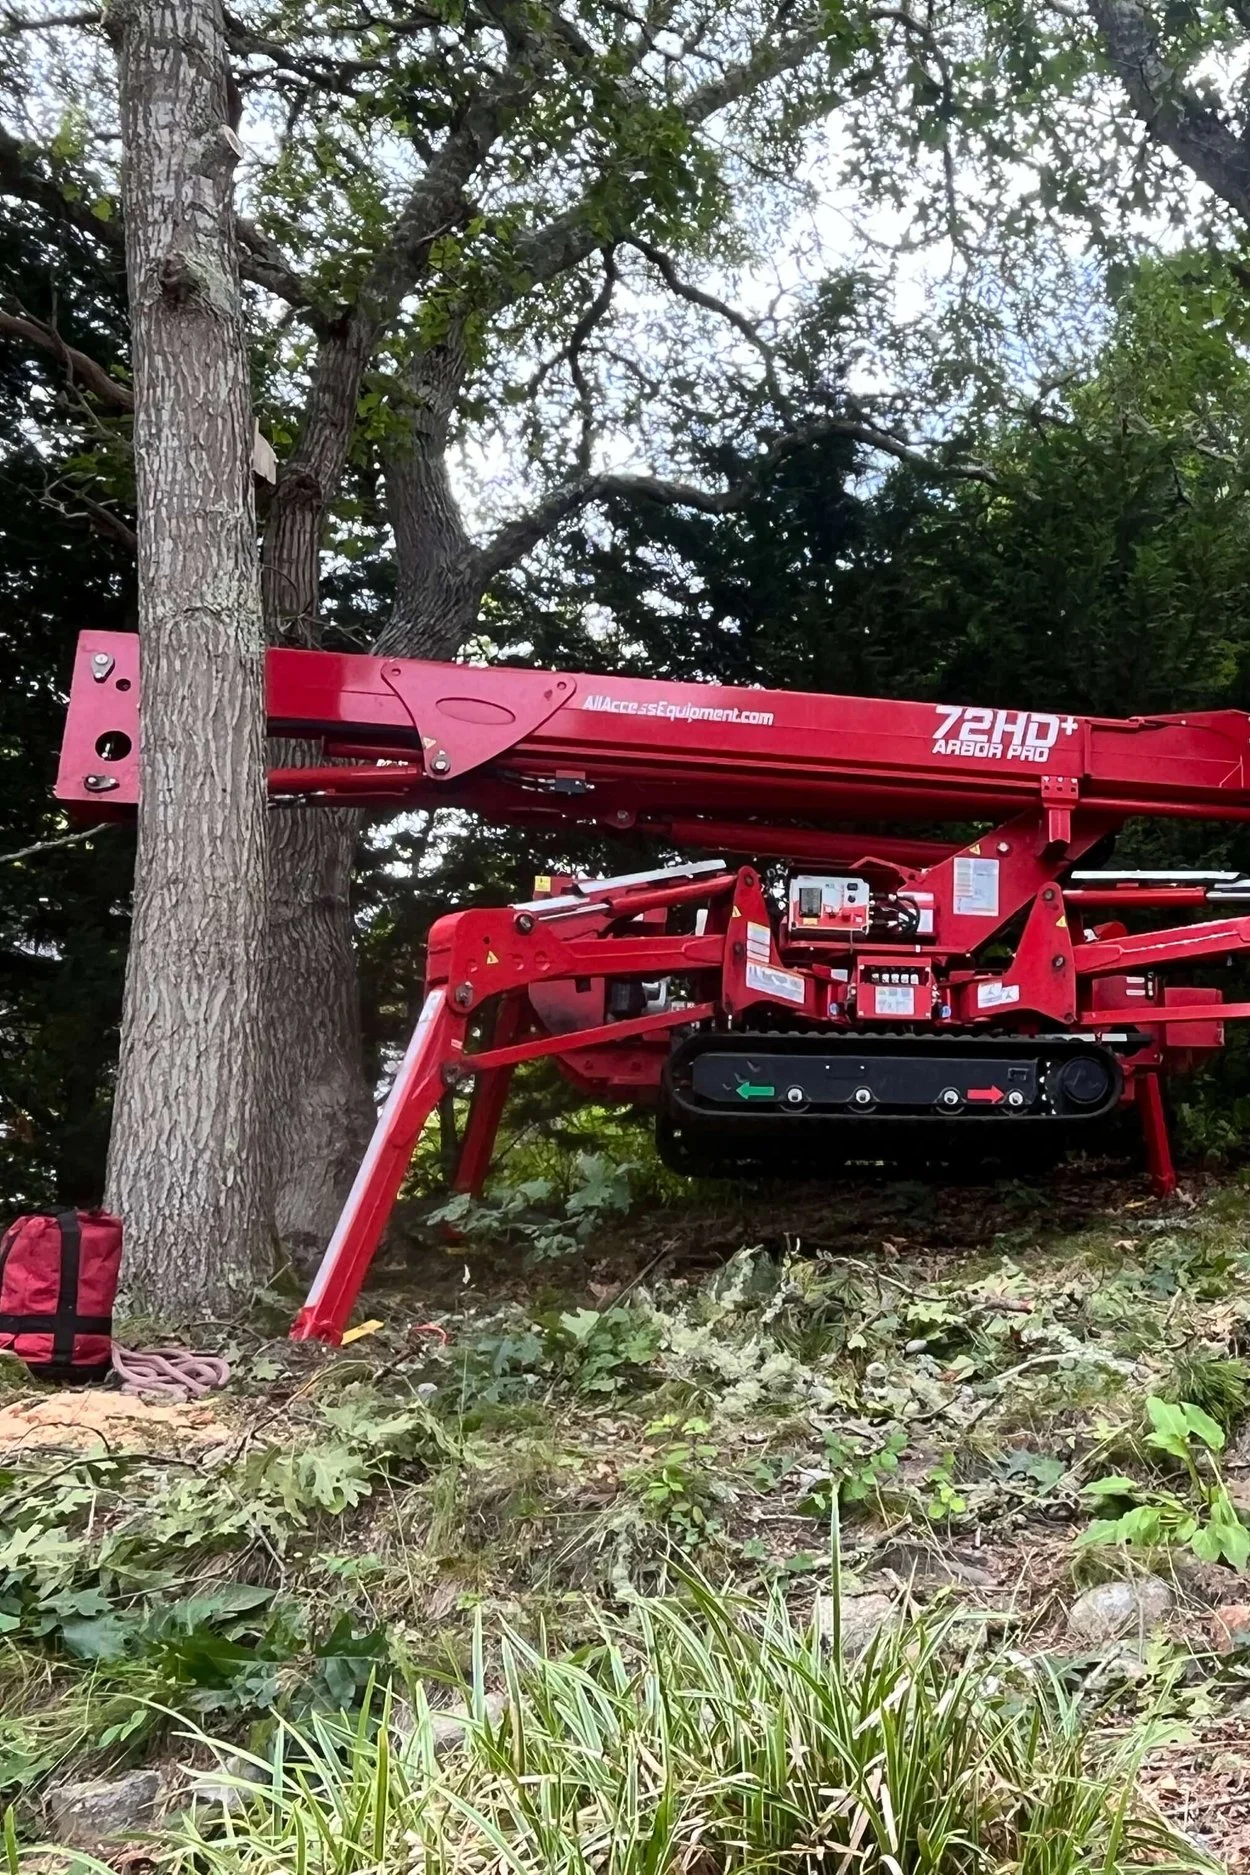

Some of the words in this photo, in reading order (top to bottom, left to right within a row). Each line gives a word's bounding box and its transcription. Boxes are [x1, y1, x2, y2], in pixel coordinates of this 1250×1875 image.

[583, 696, 773, 726] AllAccessEquipment.com
[932, 740, 1003, 758] ARBOR
[1007, 746, 1049, 762] PRO
